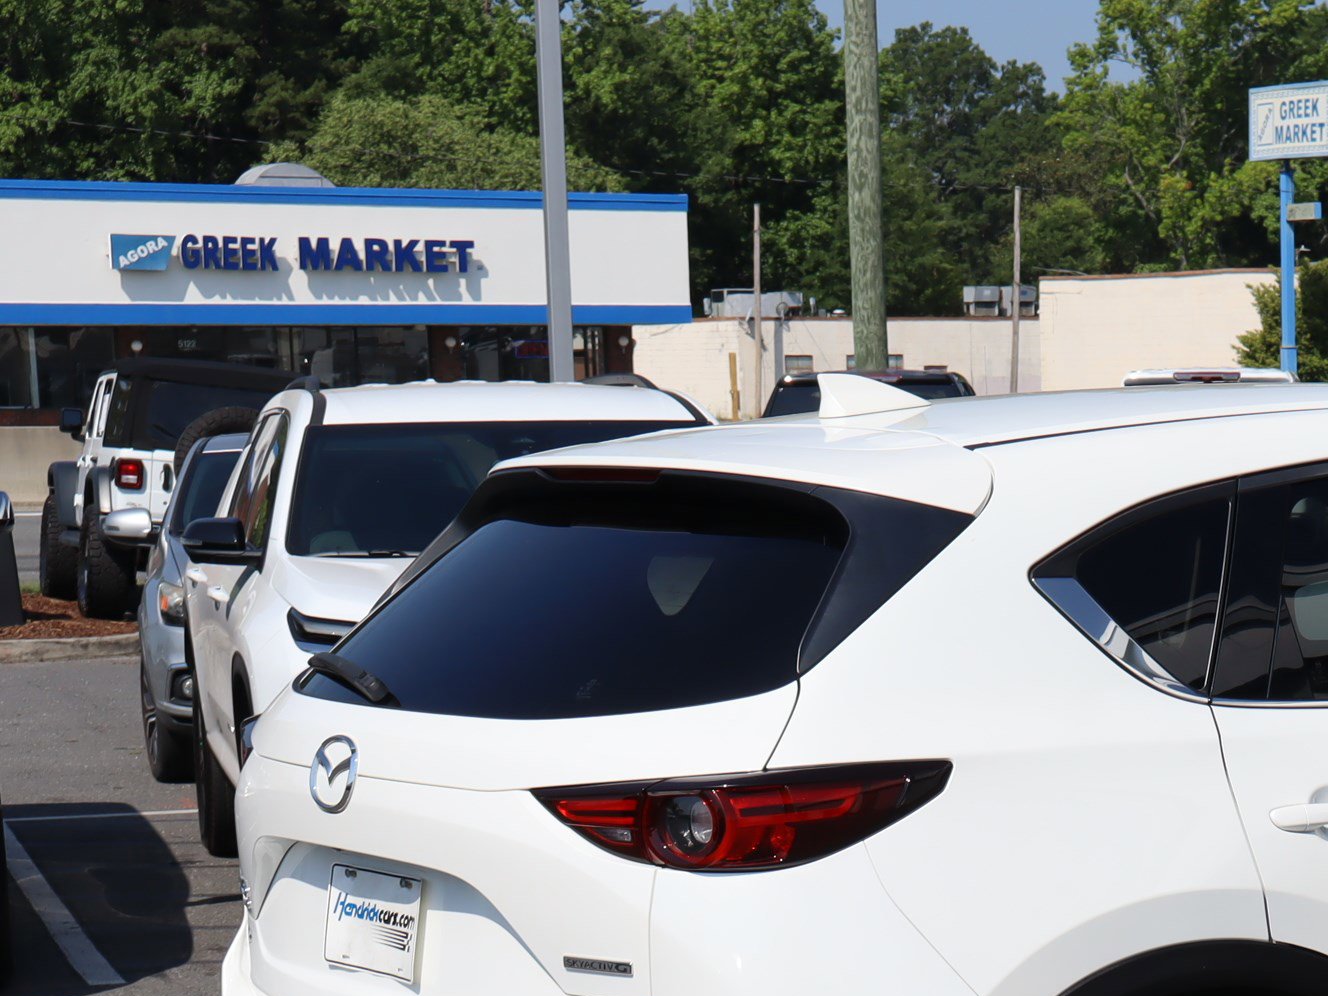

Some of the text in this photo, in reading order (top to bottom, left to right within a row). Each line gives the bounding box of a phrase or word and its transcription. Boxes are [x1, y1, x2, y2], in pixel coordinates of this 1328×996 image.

[1280, 98, 1319, 120] GREEK
[1275, 123, 1326, 144] MARKET
[118, 236, 169, 268] AGORA
[180, 234, 475, 273] GREEK MARKET
